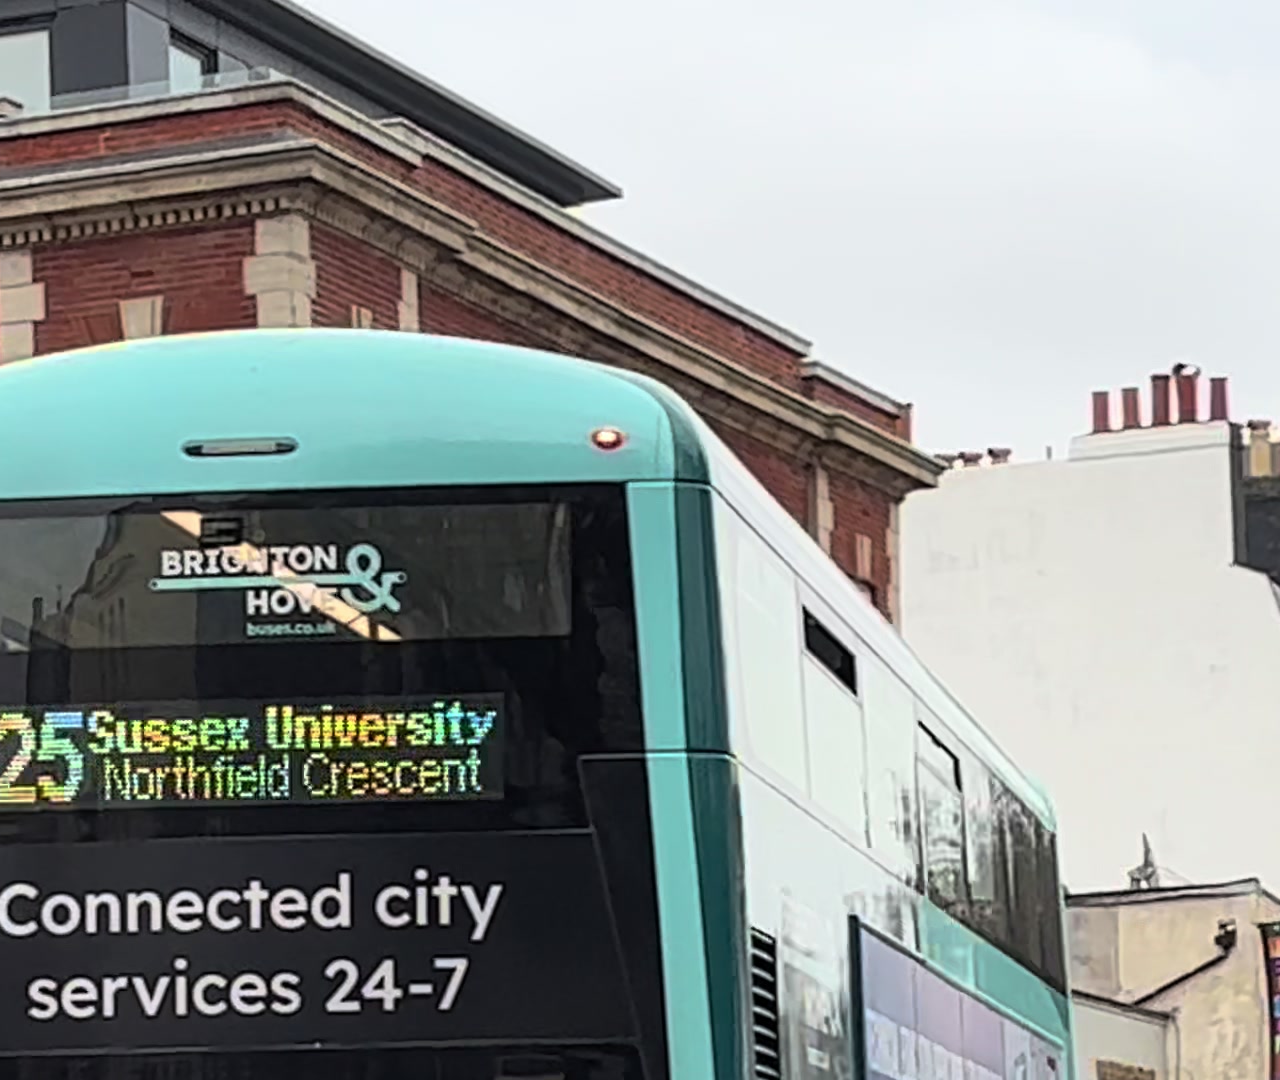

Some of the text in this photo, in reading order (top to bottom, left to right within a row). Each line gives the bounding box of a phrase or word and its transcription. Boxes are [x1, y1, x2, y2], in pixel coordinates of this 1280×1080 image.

[161, 545, 337, 576] BRIGHTON
[246, 586, 338, 616] HOVE
[246, 622, 336, 637] buses.co.uk
[87, 710, 250, 754] Sussex
[265, 700, 497, 750] University
[104, 748, 483, 800] Northfield Crescent
[375, 868, 504, 942] city
[27, 957, 470, 1020] services 24-7
